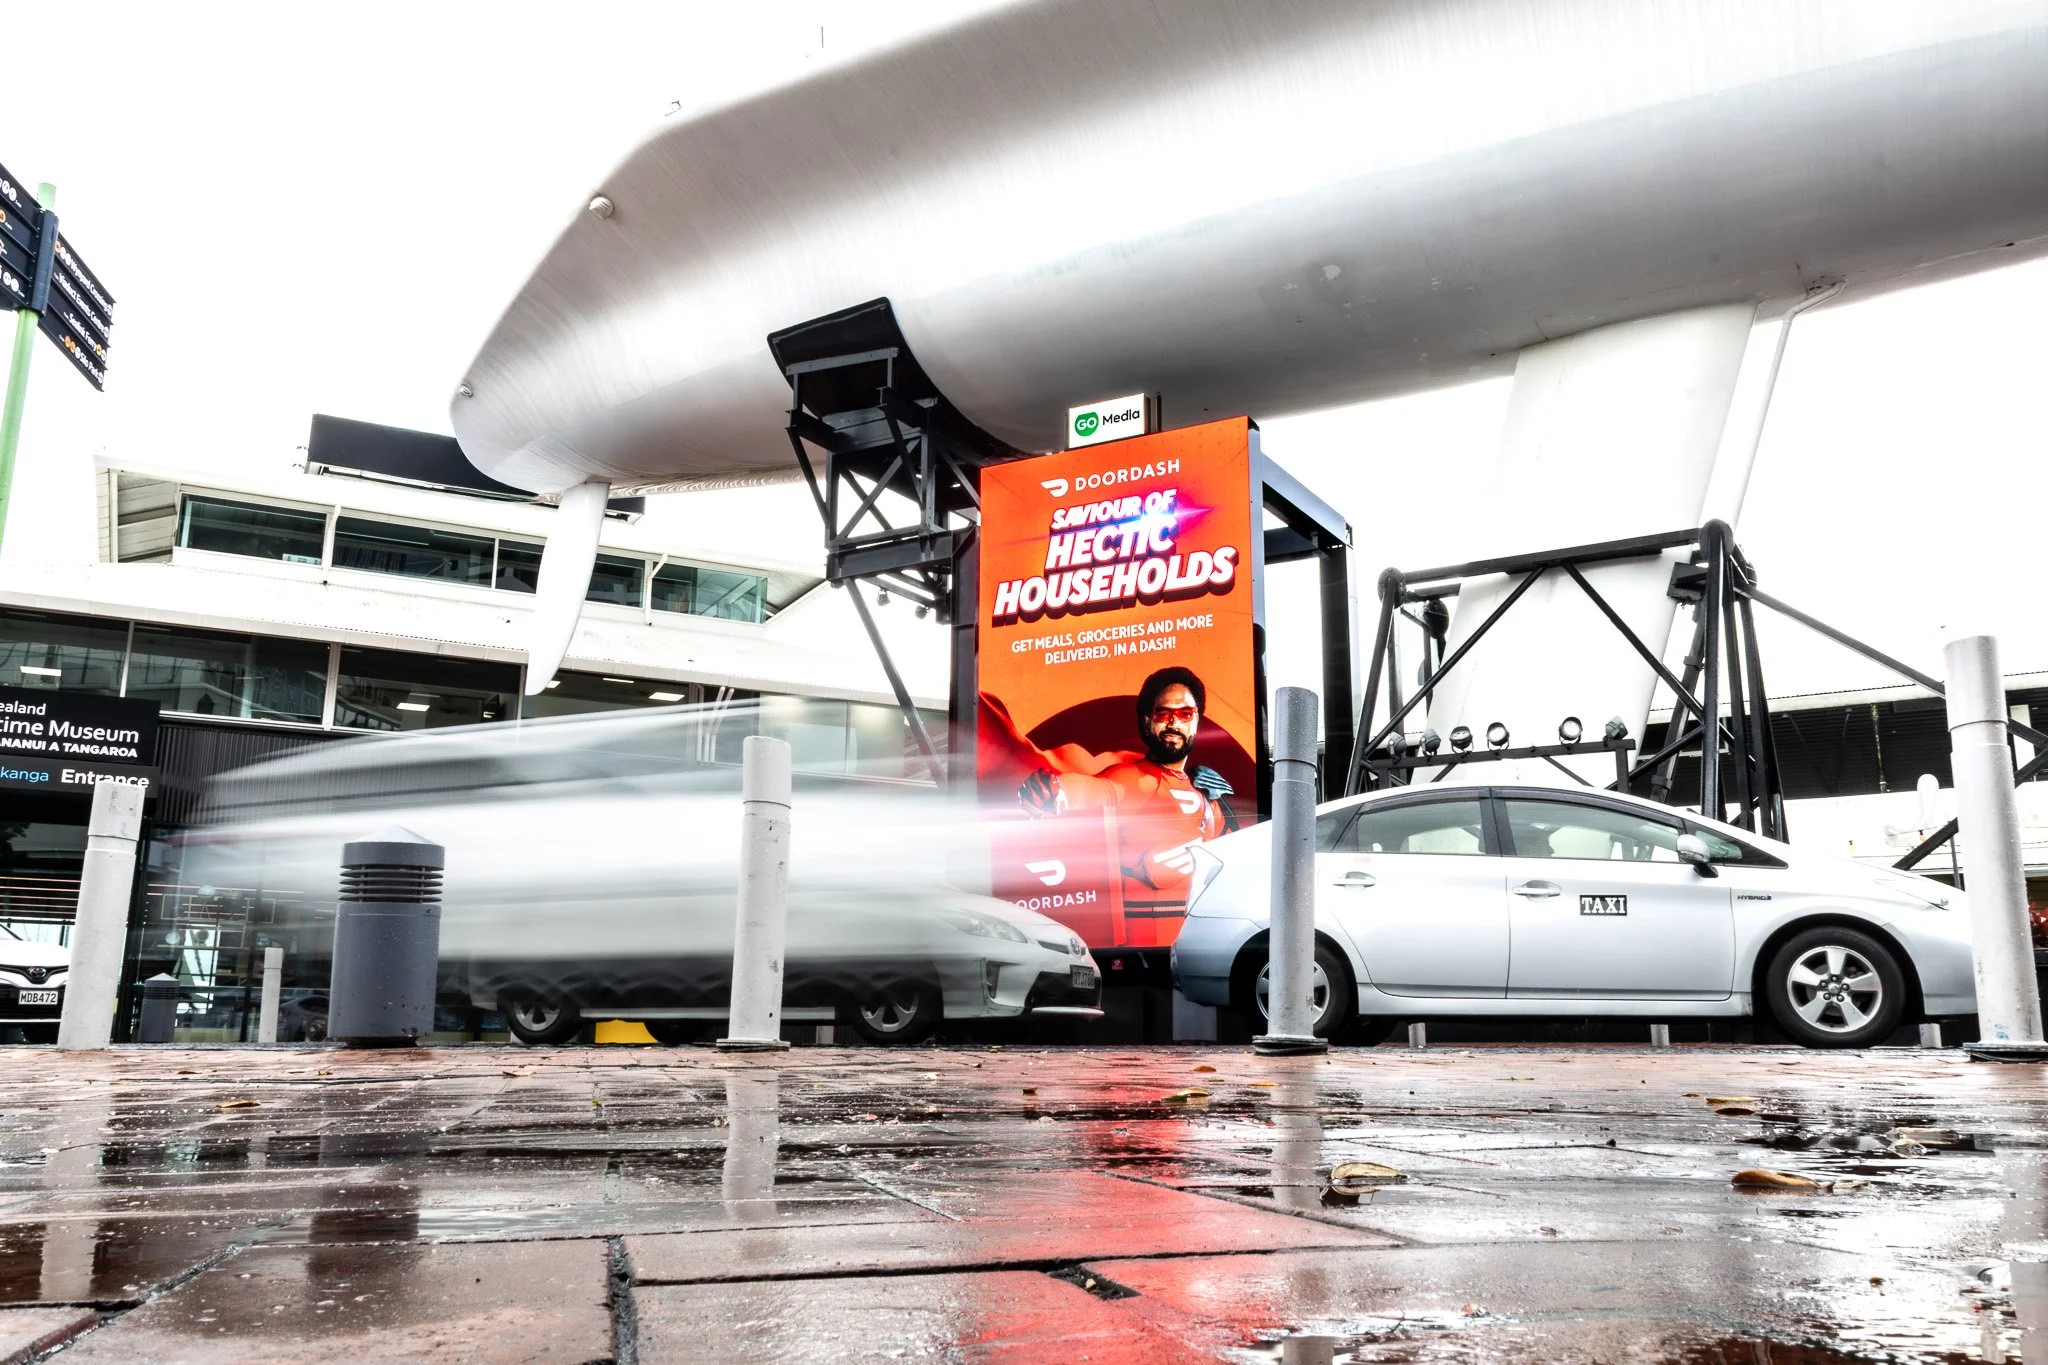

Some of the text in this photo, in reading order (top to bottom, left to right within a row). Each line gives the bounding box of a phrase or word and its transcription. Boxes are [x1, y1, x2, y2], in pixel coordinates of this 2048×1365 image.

[59, 272, 77, 300] Viaduct
[76, 294, 91, 317] Events
[85, 331, 97, 352] Ferry
[80, 352, 99, 379] Silo Park
[1076, 408, 1140, 431] GO Media
[1075, 458, 1180, 492] DOORDASH
[1051, 488, 1178, 529] SAVIOUR OF
[1044, 515, 1179, 571] HECTIC
[992, 546, 1239, 618] HOUSEHOLDS
[1011, 613, 1214, 654] GET MEALS, GROCERIES AND MORE
[1045, 636, 1176, 665] DELIVERED, IN A DASH!
[48, 719, 140, 744] Museum
[0, 737, 138, 758] NANUI A TANGAROA
[0, 766, 150, 789] kanga Entrance
[1010, 890, 1097, 911] OORDASH
[1581, 896, 1627, 914] TAXI
[20, 992, 57, 1003] MDB472
